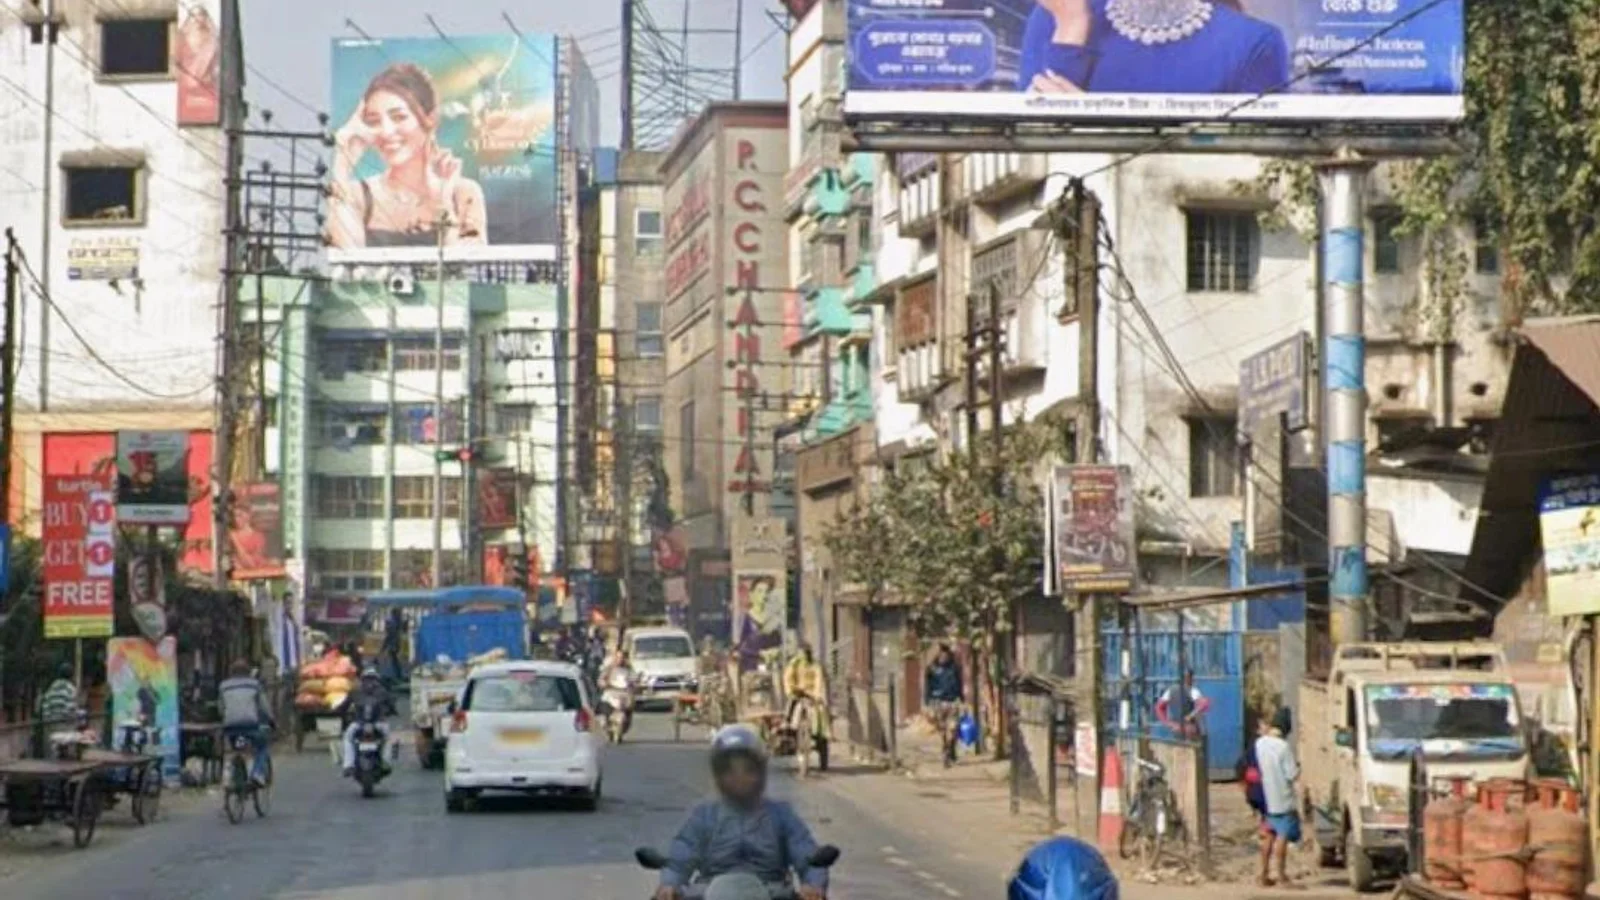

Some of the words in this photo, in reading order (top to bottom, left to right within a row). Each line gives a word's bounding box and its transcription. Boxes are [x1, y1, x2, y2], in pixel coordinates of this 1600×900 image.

[46, 502, 88, 526] BUY
[46, 541, 85, 566] GET
[48, 581, 110, 606] FREE
